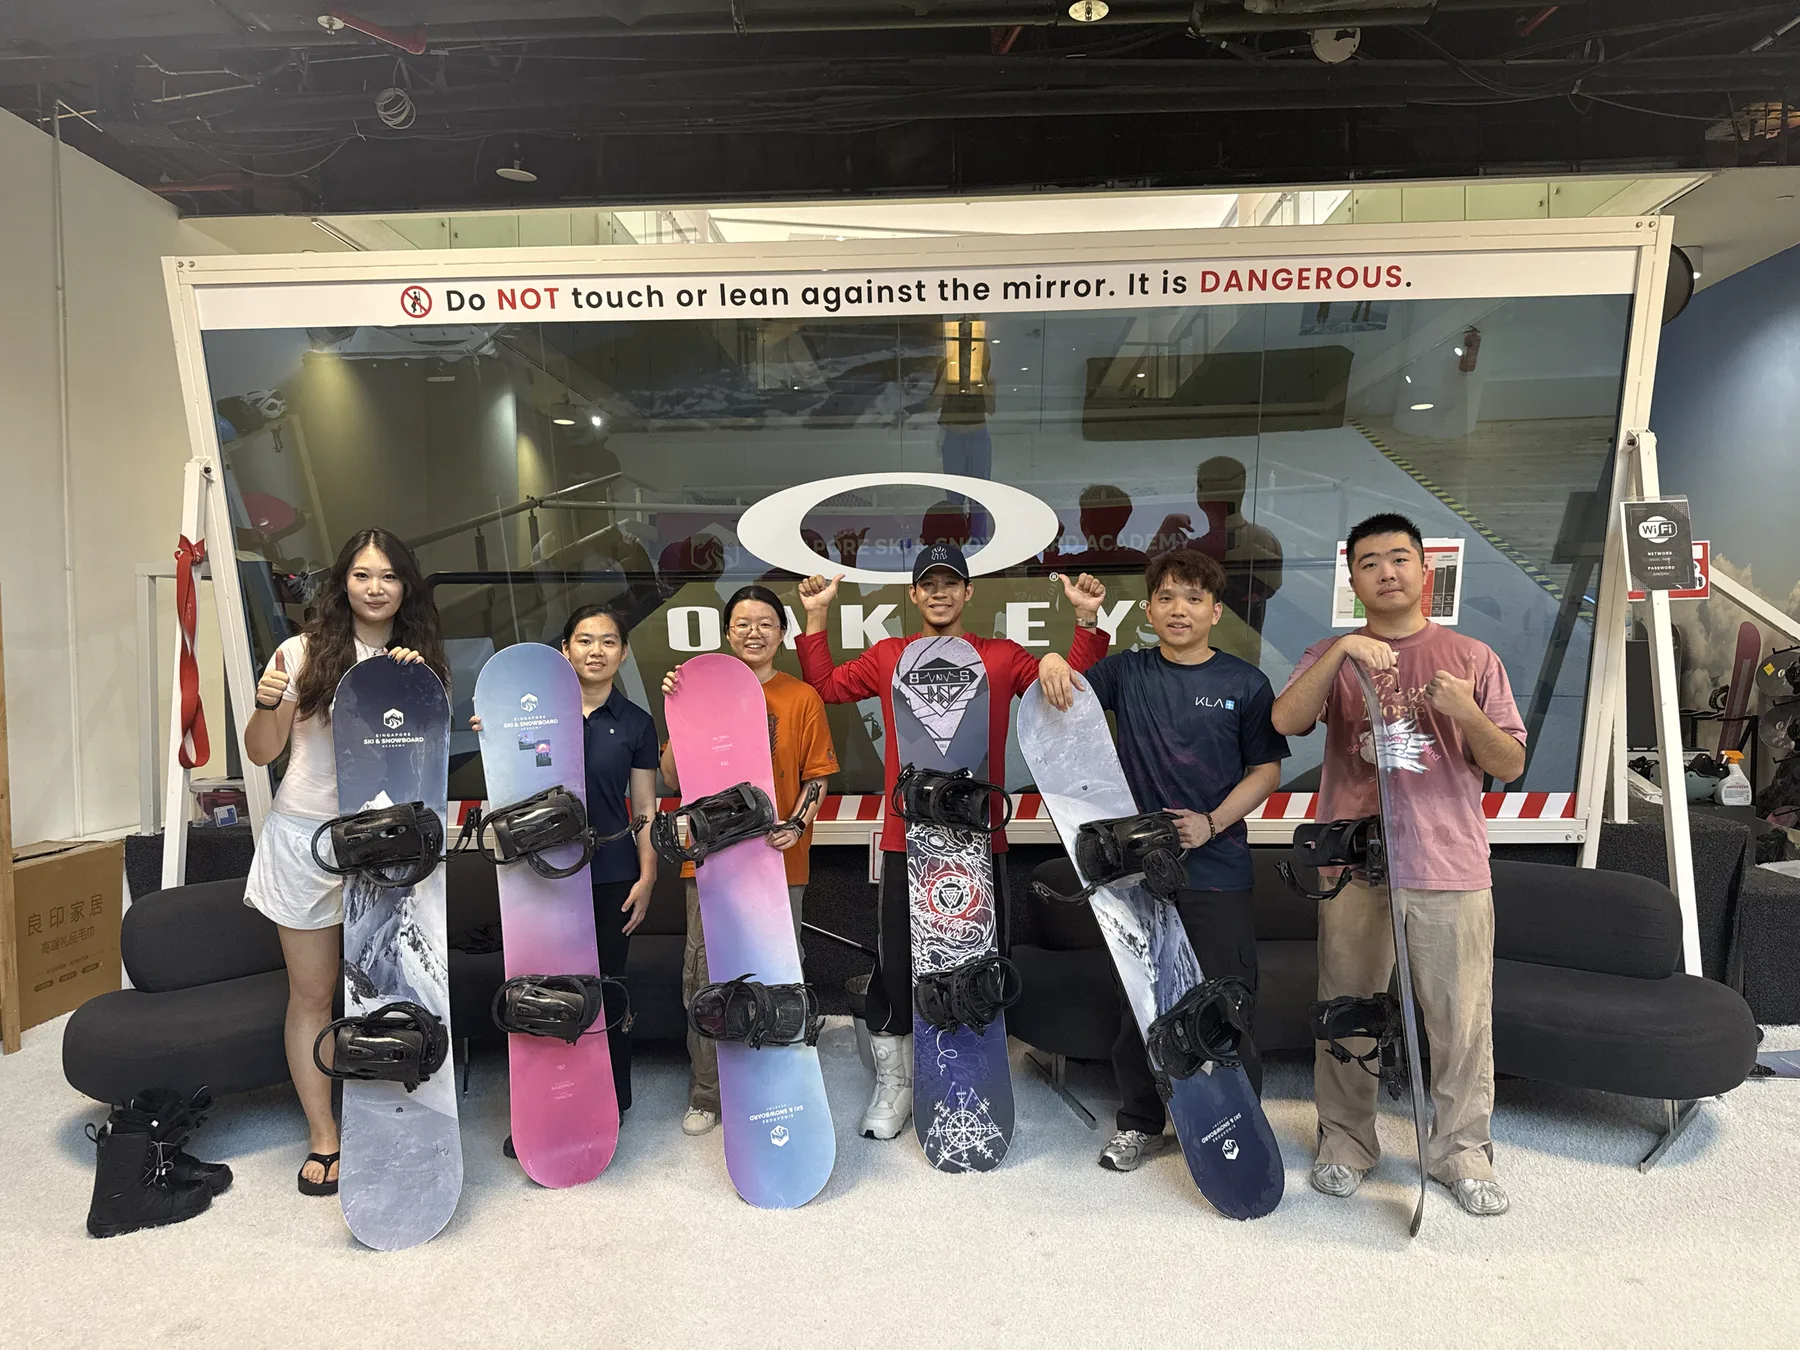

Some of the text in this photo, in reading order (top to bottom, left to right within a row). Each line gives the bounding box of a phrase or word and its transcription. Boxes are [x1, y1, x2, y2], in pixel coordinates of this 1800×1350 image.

[446, 264, 1413, 313] Do NOT touch or lean against the mirror. It is DANGEROUS.
[1195, 696, 1224, 709] KLA
[520, 718, 559, 727] SNOWBOARD
[381, 736, 425, 744] SNOWBOARD
[27, 893, 104, 937] 良印家居
[749, 1108, 788, 1121] SNOWBOARD
